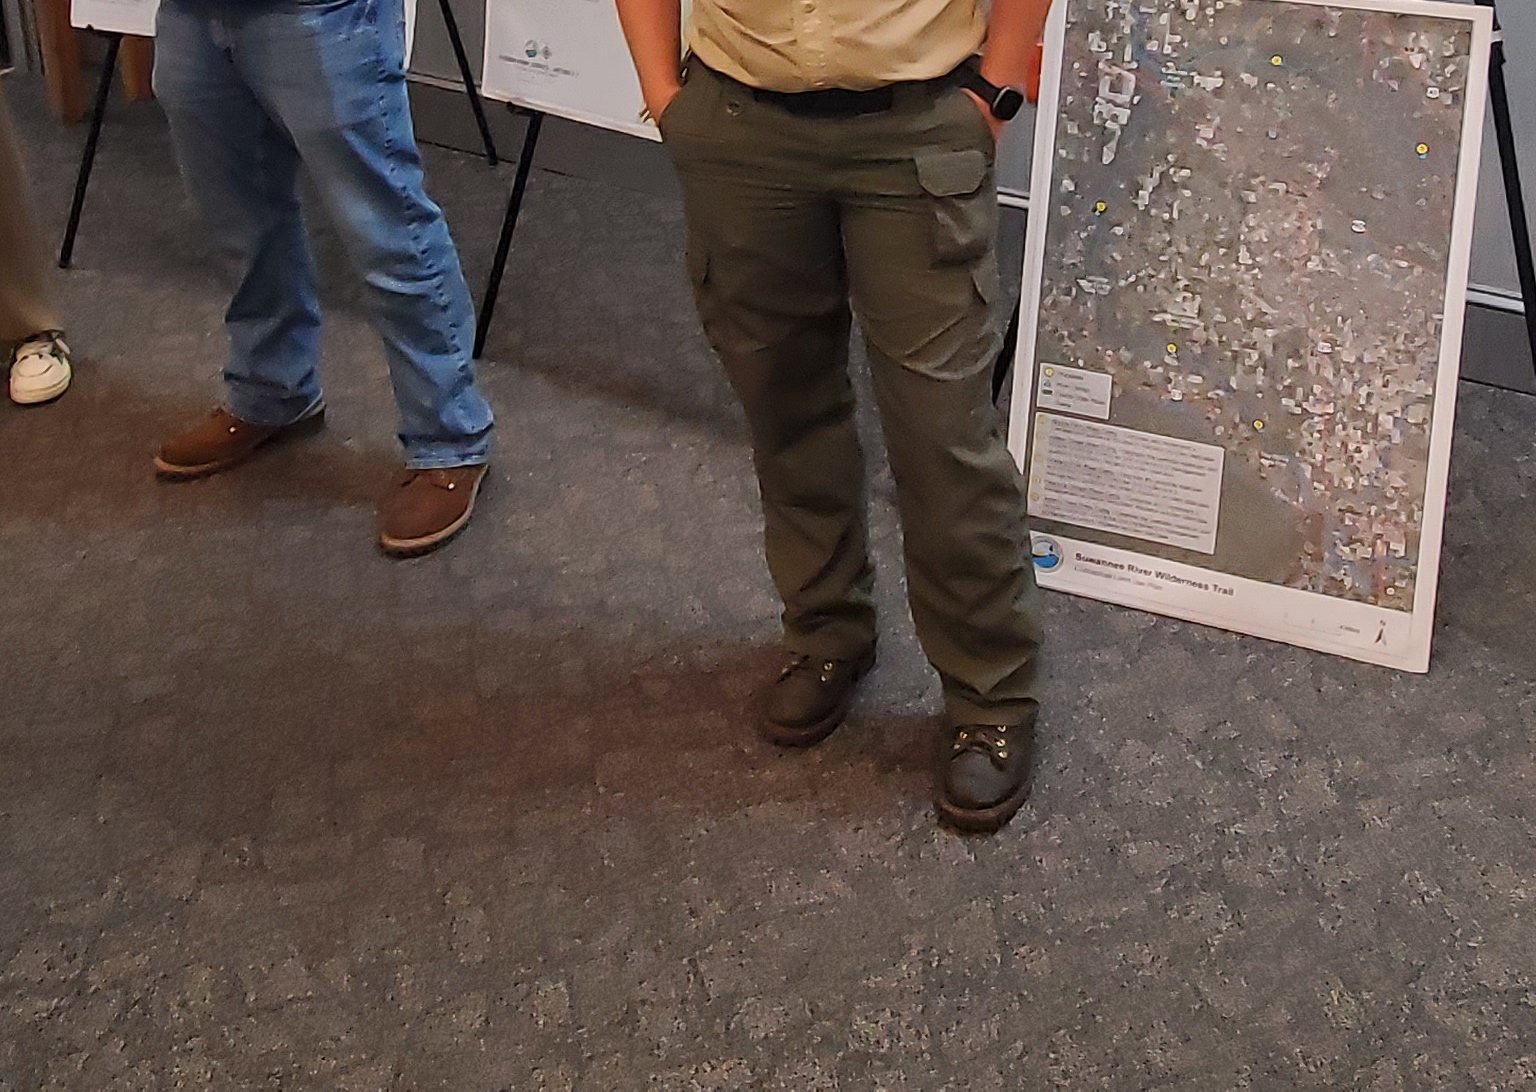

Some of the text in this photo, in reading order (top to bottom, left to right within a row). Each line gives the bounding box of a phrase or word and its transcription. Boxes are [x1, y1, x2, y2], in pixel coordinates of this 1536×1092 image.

[1127, 563, 1153, 578] River
[1154, 570, 1210, 592] Wilderness
[1212, 583, 1234, 597] Trail
